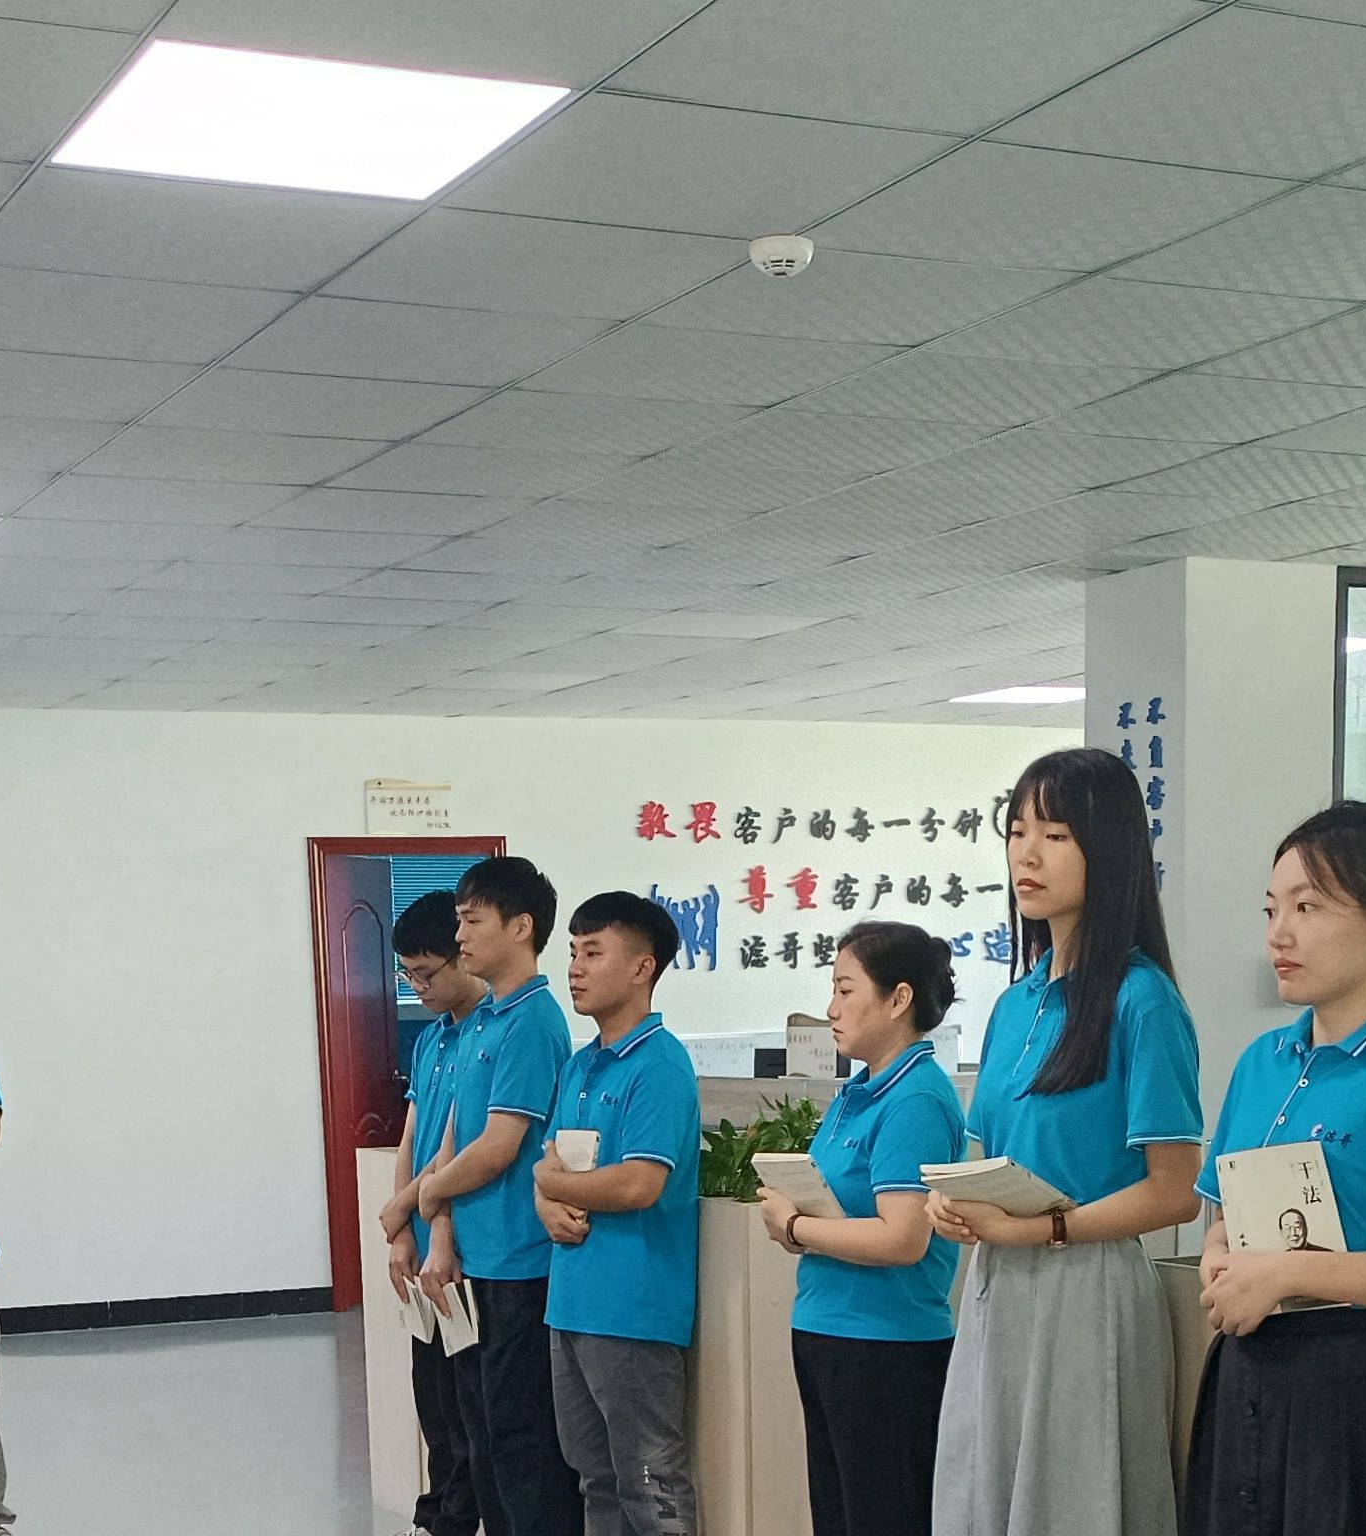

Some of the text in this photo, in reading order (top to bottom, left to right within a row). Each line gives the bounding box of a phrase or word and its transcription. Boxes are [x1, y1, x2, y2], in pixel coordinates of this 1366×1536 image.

[636, 800, 983, 845] 敬畏客户的每一分钟
[1297, 1161, 1322, 1205] 干法
